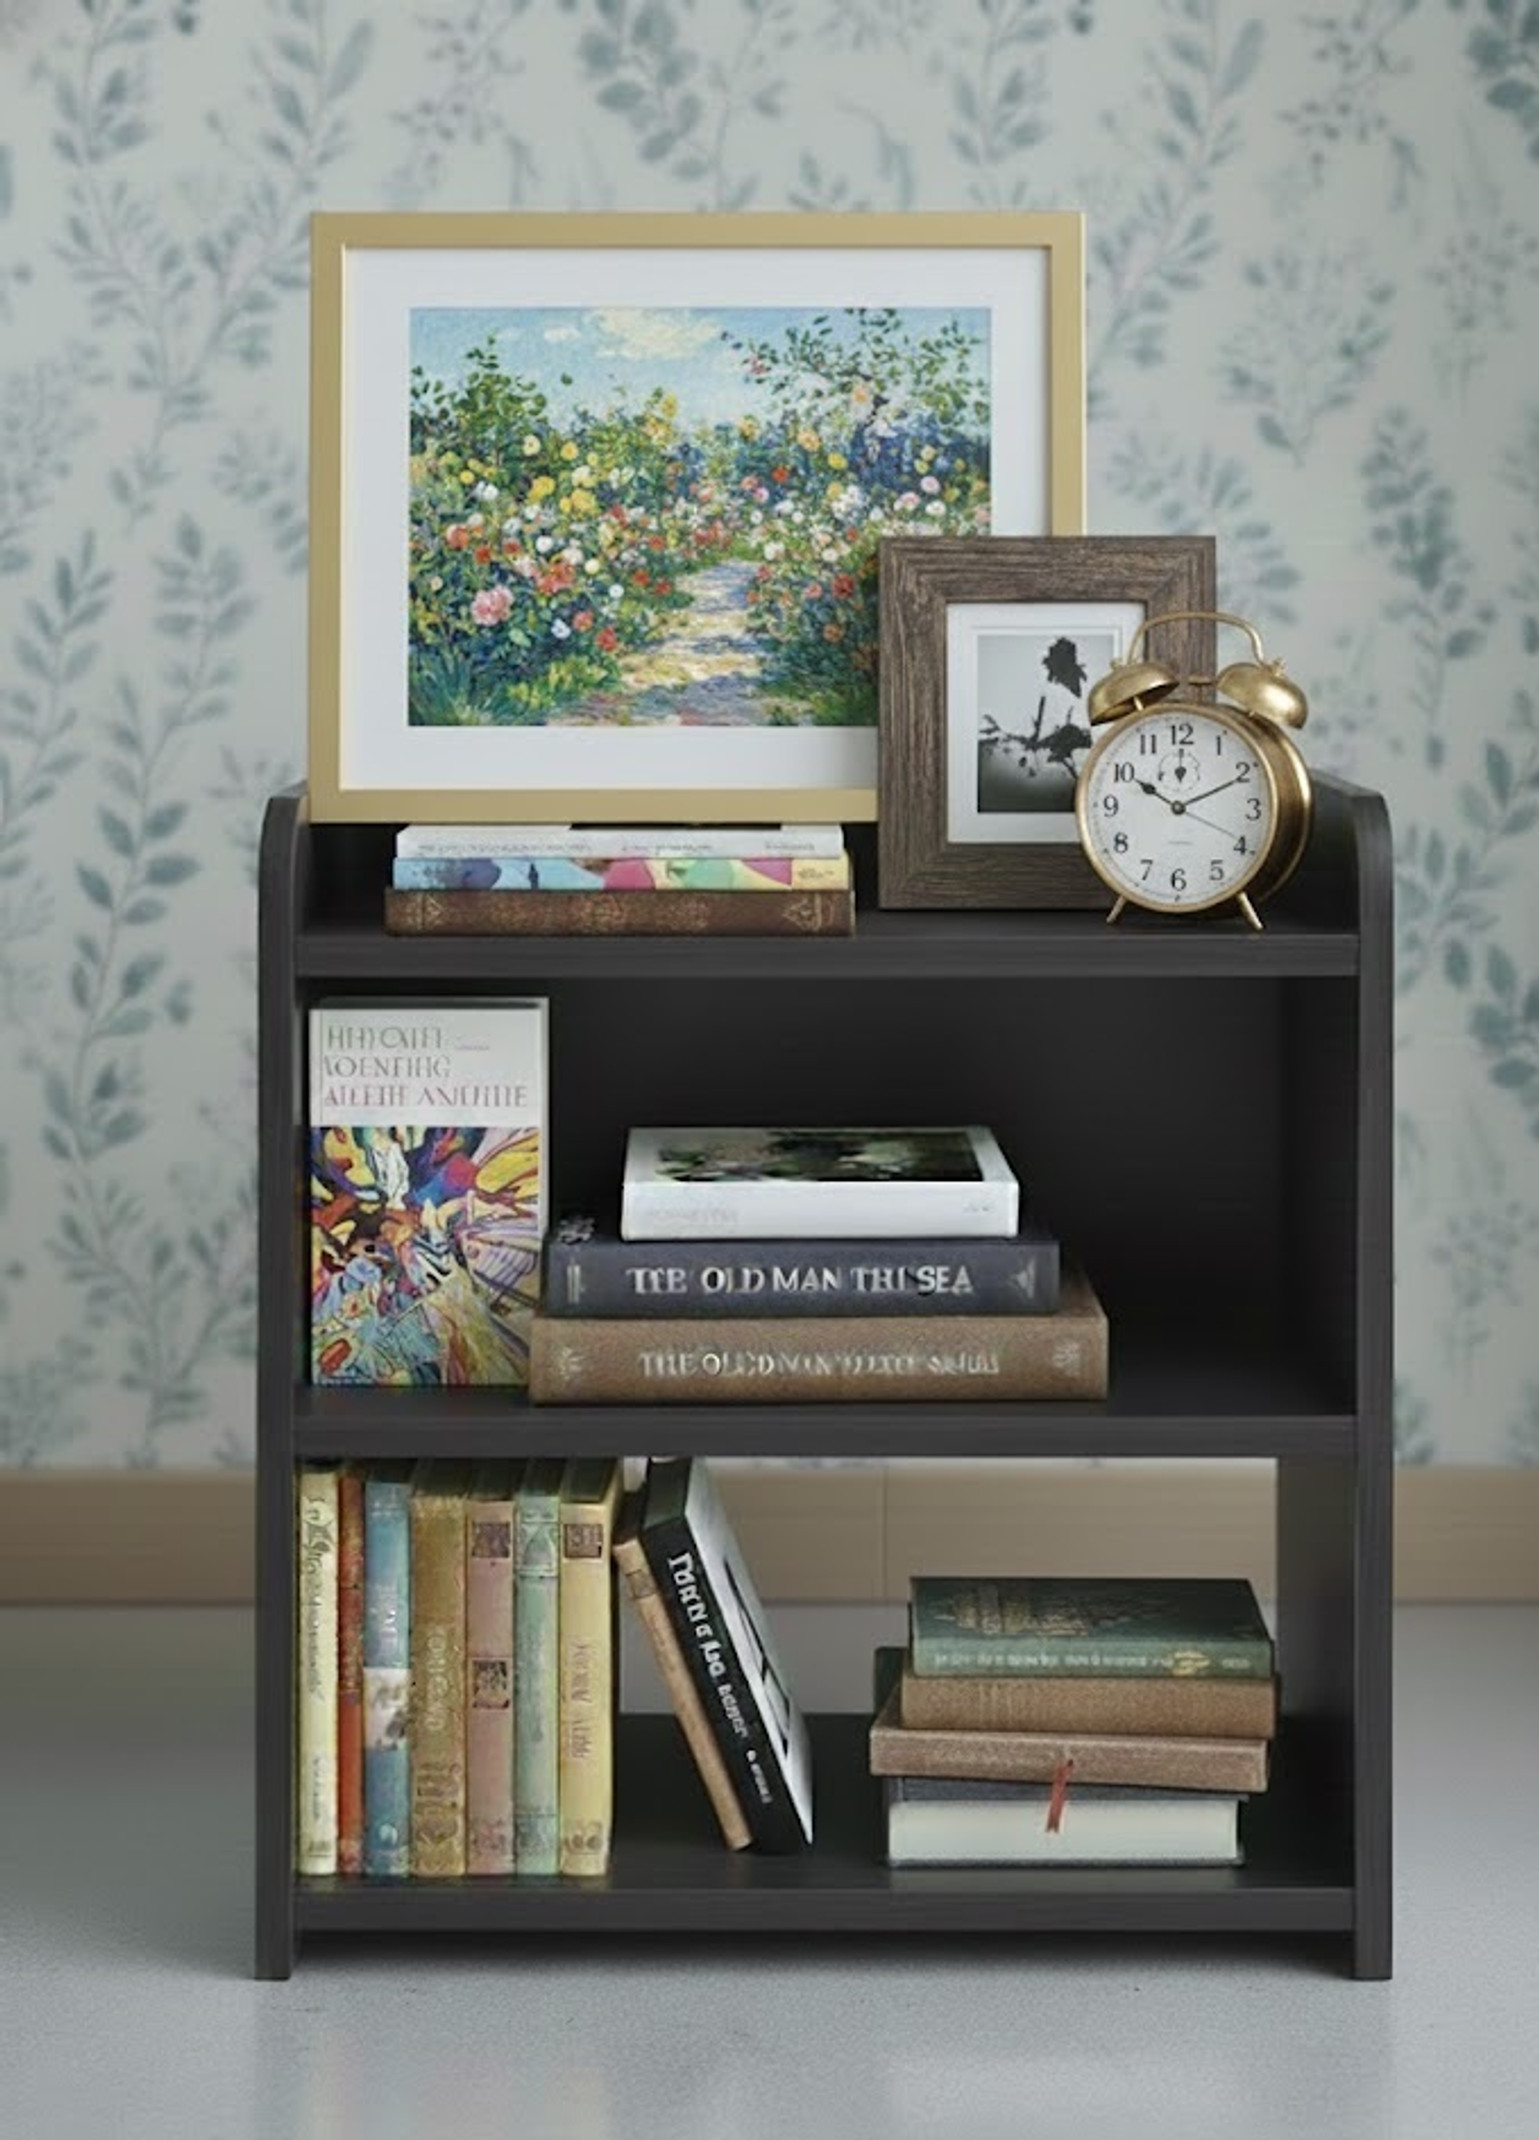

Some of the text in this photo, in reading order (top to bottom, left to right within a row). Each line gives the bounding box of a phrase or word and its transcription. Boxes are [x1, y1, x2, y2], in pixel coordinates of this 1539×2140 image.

[1139, 734, 1157, 755] 11
[1170, 723, 1195, 746] 12
[1216, 735, 1222, 756] 1
[1113, 762, 1136, 783] 10
[1235, 761, 1251, 783] 2
[1103, 794, 1119, 817] 9
[1245, 799, 1262, 821] 3
[1113, 832, 1129, 854] 8
[1233, 836, 1247, 856] 4
[1140, 859, 1154, 881] 7
[1170, 868, 1187, 892] 6
[1209, 859, 1224, 881] 5
[701, 1266, 764, 1294] OLD
[772, 1266, 842, 1293] MAN
[915, 1264, 974, 1295] SEA
